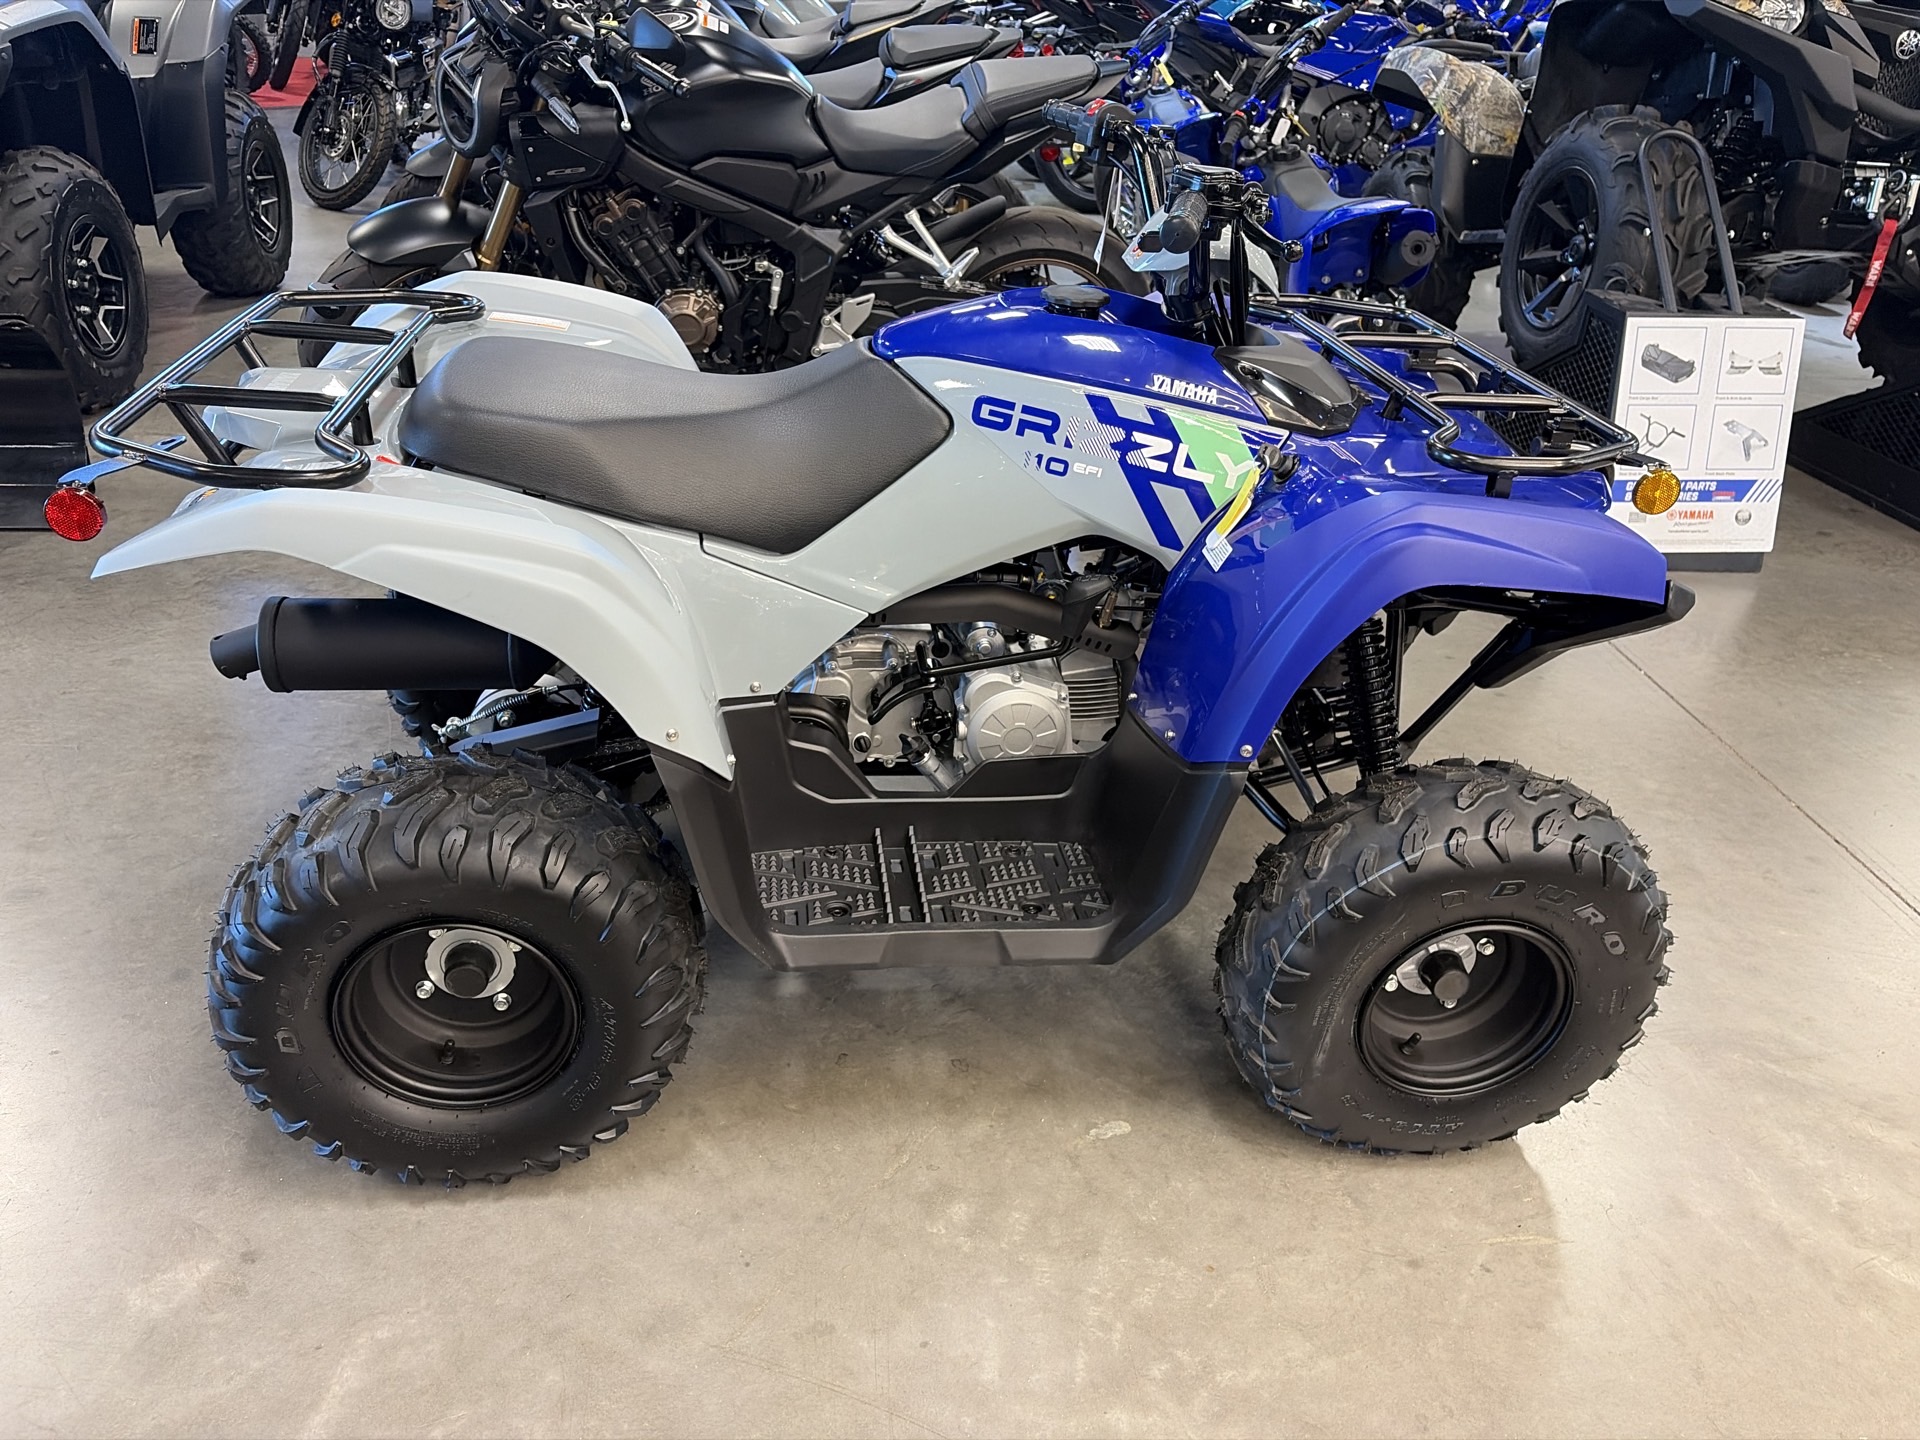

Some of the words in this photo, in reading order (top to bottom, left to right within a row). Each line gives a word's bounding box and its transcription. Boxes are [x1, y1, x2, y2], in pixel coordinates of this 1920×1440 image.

[1865, 260, 1882, 287] WARN
[1152, 374, 1218, 404] YAMAHA
[971, 394, 1257, 490] GRIZZLY
[1073, 462, 1104, 478] EFI
[1685, 481, 1717, 491] PARTS
[1678, 510, 1714, 520] YAMAHA
[1487, 879, 1627, 956] DURO
